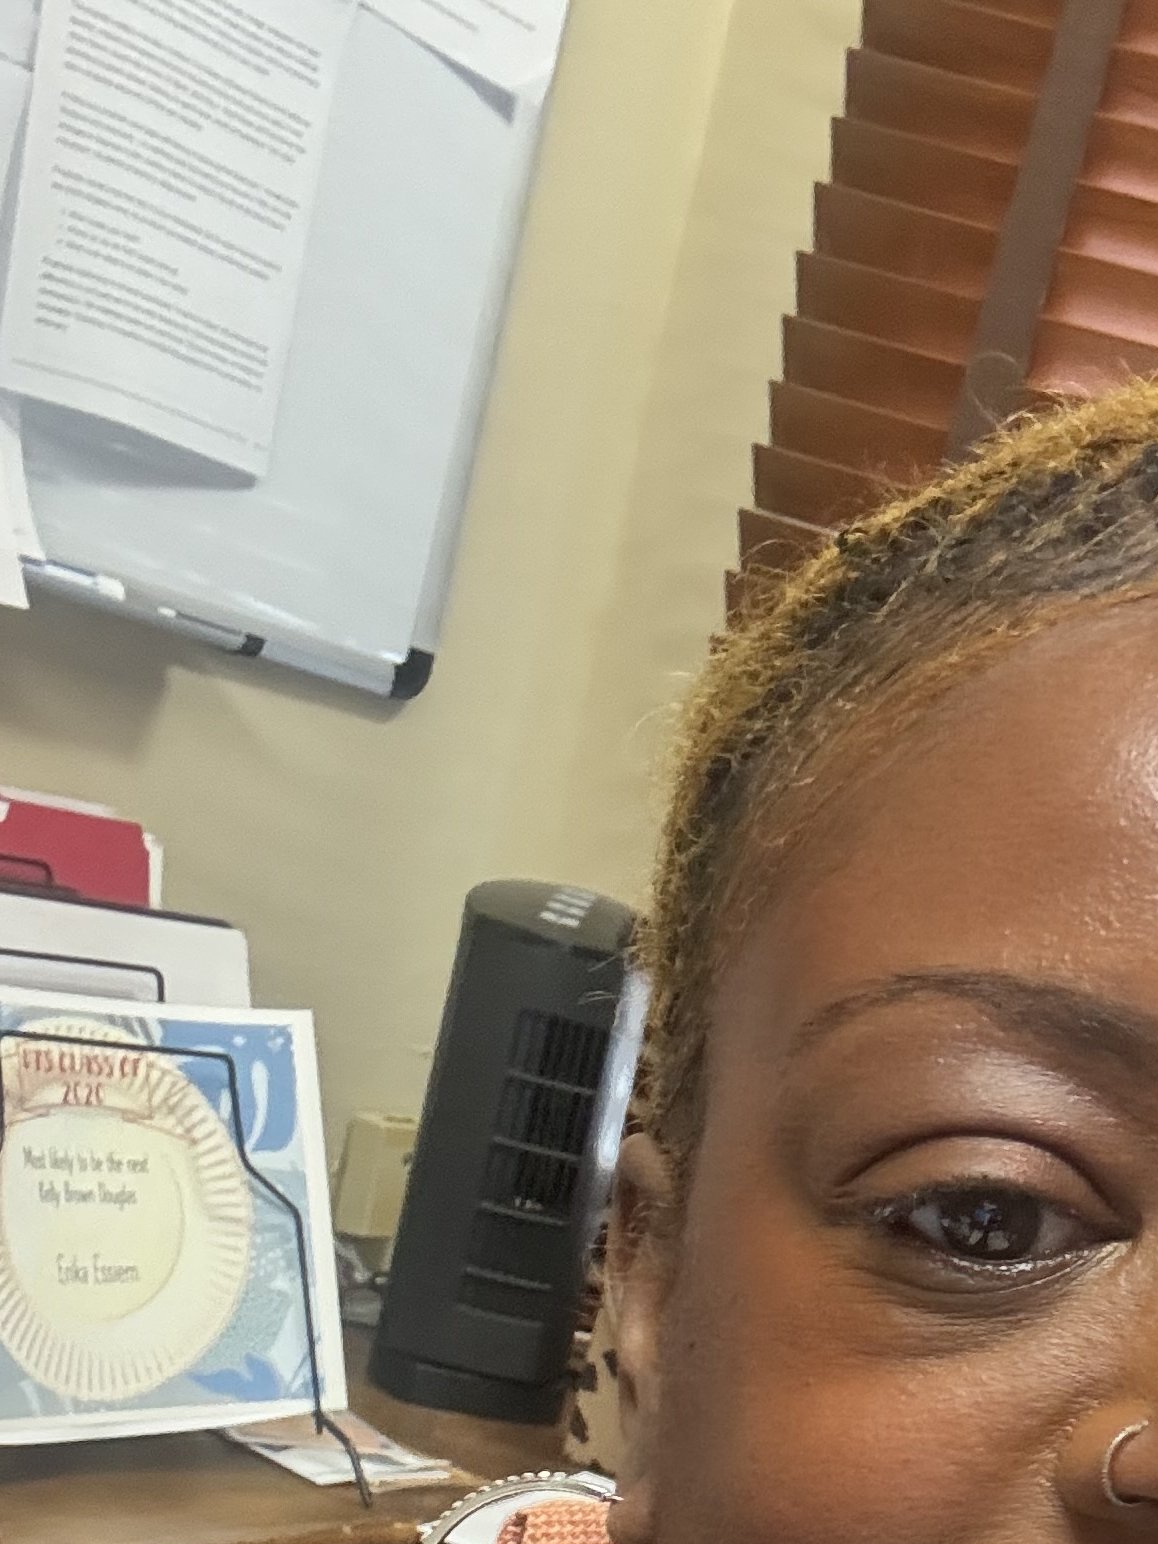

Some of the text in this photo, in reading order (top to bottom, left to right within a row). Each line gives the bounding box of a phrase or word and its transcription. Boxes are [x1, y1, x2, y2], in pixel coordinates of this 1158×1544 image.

[22, 1145, 150, 1177] Most likely to be the next
[63, 1180, 96, 1204] Brown
[97, 1182, 138, 1212] Douglas
[56, 1252, 90, 1286] Erika
